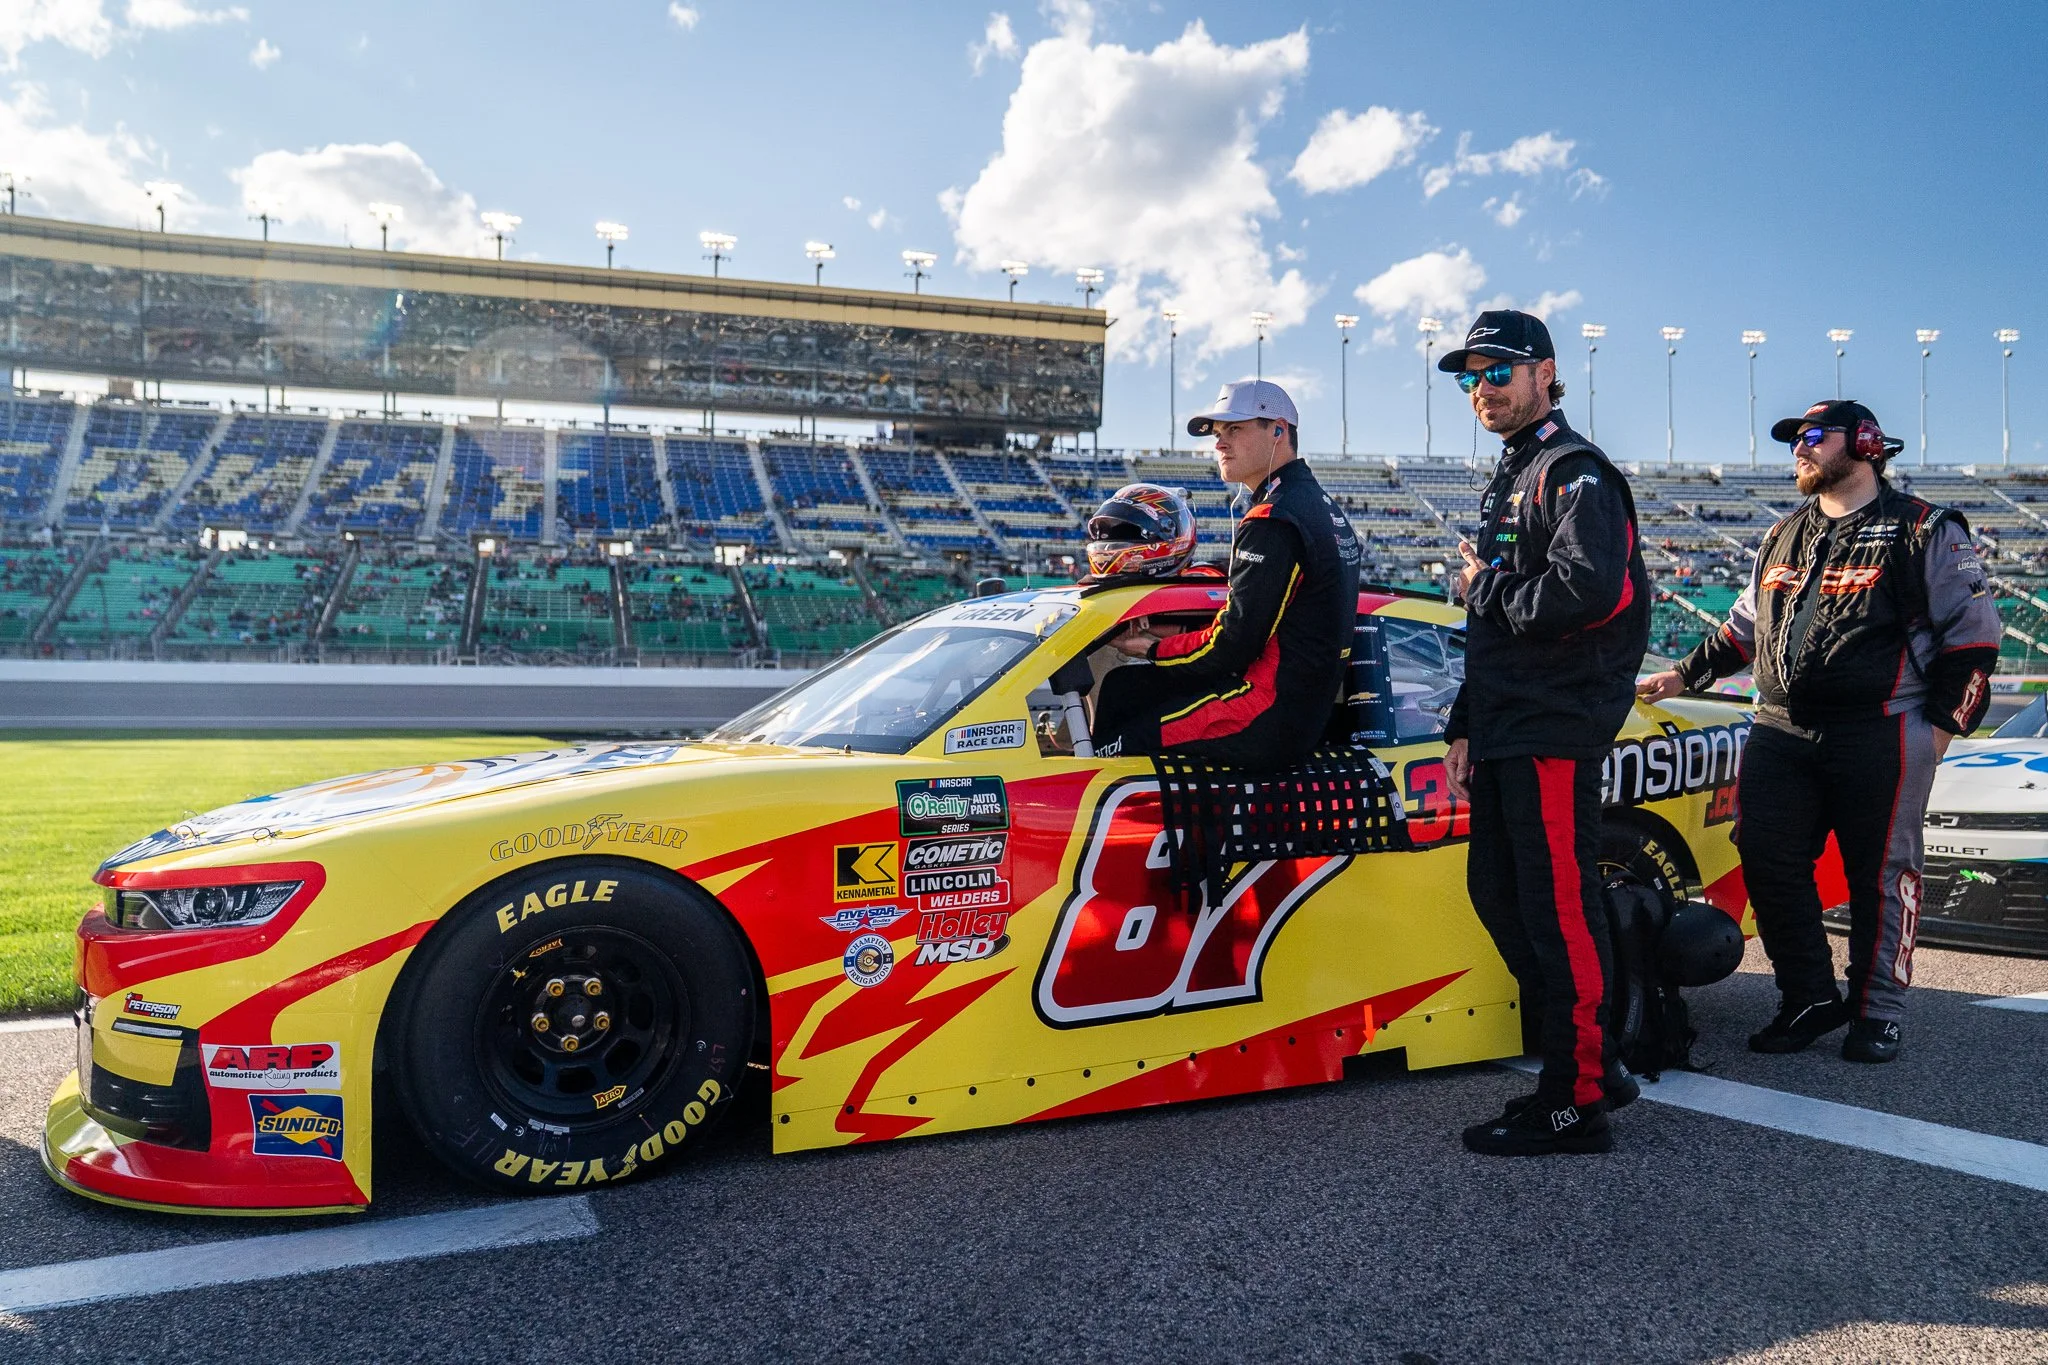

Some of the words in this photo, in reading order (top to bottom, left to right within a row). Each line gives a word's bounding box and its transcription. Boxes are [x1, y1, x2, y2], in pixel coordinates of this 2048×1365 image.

[1239, 550, 1264, 563] NASCAR
[952, 608, 1035, 622] GREEN
[971, 723, 1015, 737] NASCAR
[957, 738, 988, 749] RACE
[991, 736, 1014, 745] CAR
[939, 778, 972, 788] NASCAR
[908, 794, 969, 819] O'Reilly
[972, 793, 997, 804] AUTO
[970, 803, 1001, 815] PARTS
[941, 823, 970, 834] SERIES
[490, 820, 688, 861] GOODYEAR
[908, 840, 1003, 866] COMETIC
[1924, 844, 1989, 856] ROLET
[914, 862, 951, 870] GASKET
[1643, 840, 1686, 903] EAGLE
[910, 872, 992, 893] LINCOLN
[836, 886, 896, 900] KENNAMETAL
[930, 891, 1000, 908] WELDERS
[496, 880, 619, 934] EAGLE
[1032, 774, 1356, 1030] 87
[837, 910, 865, 921] FIVE
[868, 907, 896, 917] STAR
[917, 910, 1009, 942] Holley
[849, 937, 889, 954] CHAMPION
[914, 938, 996, 966] MSD
[849, 965, 889, 984] IRRIGATION
[128, 1000, 181, 1015] PETERSON
[150, 1012, 177, 1020] RACING
[209, 1044, 334, 1071] ARP
[209, 1070, 263, 1080] automotive
[264, 1069, 291, 1089] Racing
[293, 1069, 338, 1080] products
[599, 1087, 623, 1104] AERO
[260, 1116, 341, 1136] SUNOCO
[494, 1079, 721, 1186] GOODYEAR
